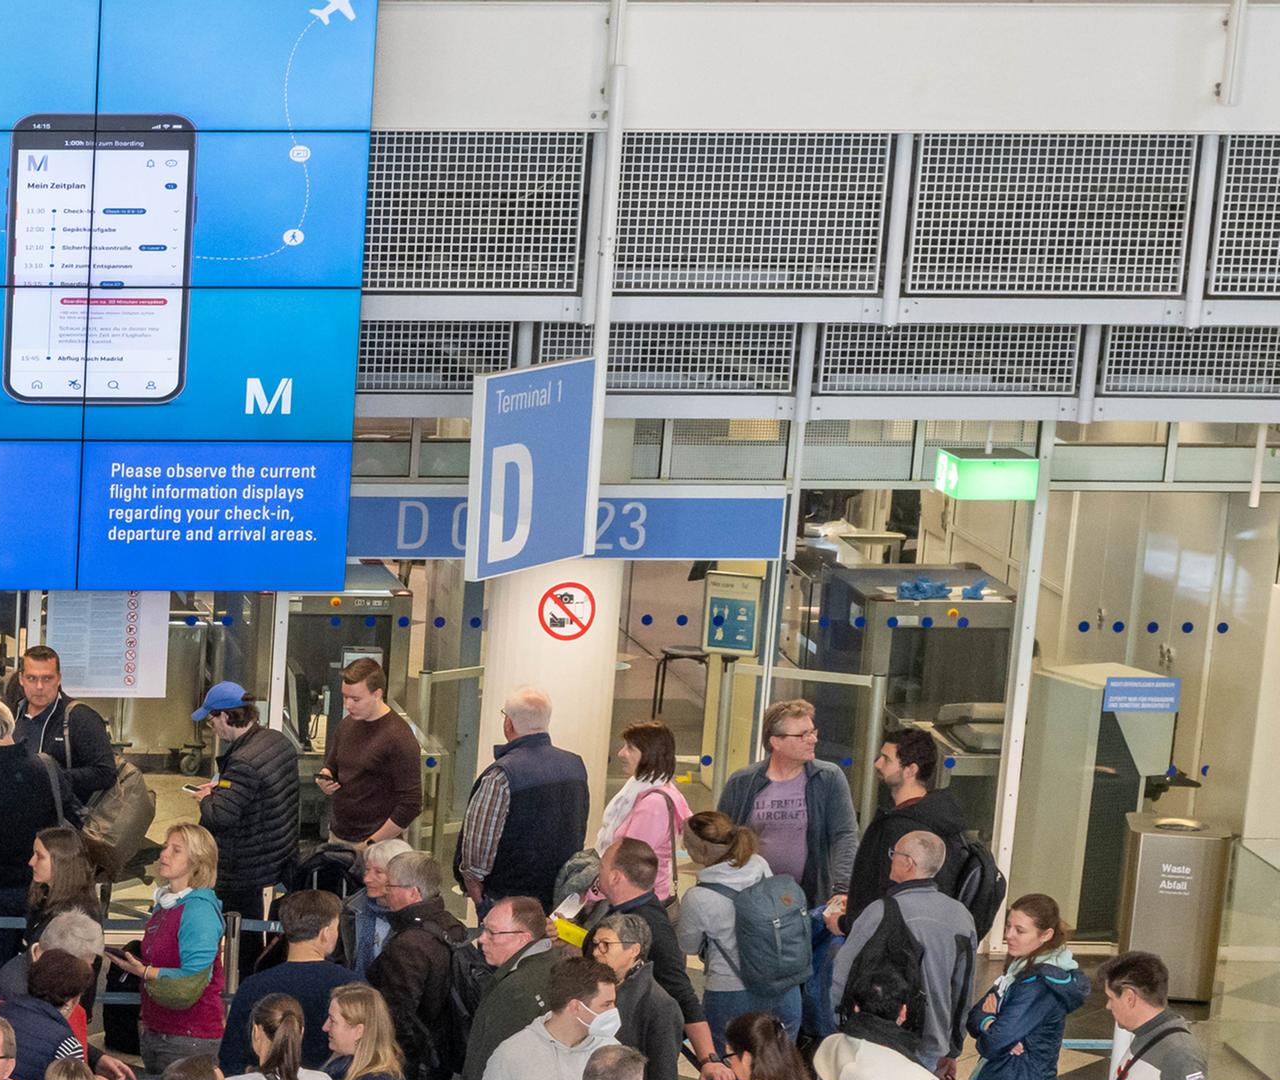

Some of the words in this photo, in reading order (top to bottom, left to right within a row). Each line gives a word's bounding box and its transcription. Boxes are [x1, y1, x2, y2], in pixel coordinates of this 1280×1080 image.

[245, 378, 292, 414] M
[496, 381, 551, 414] Terminal
[558, 380, 562, 402] 1
[112, 463, 161, 478] Please
[167, 464, 226, 478] observe
[231, 464, 255, 478] the
[261, 466, 316, 478] current
[110, 484, 147, 502] flight
[152, 484, 238, 499] information
[242, 484, 304, 503] displays
[487, 443, 533, 564] D
[109, 505, 181, 523] regarding
[186, 509, 220, 523] your
[225, 505, 293, 521] check-in,
[108, 526, 180, 543] departure
[186, 526, 213, 540] and
[218, 527, 265, 541] arrival
[271, 530, 316, 541] areas.
[1162, 864, 1191, 874] Waste
[1160, 880, 1187, 890] Abfall
